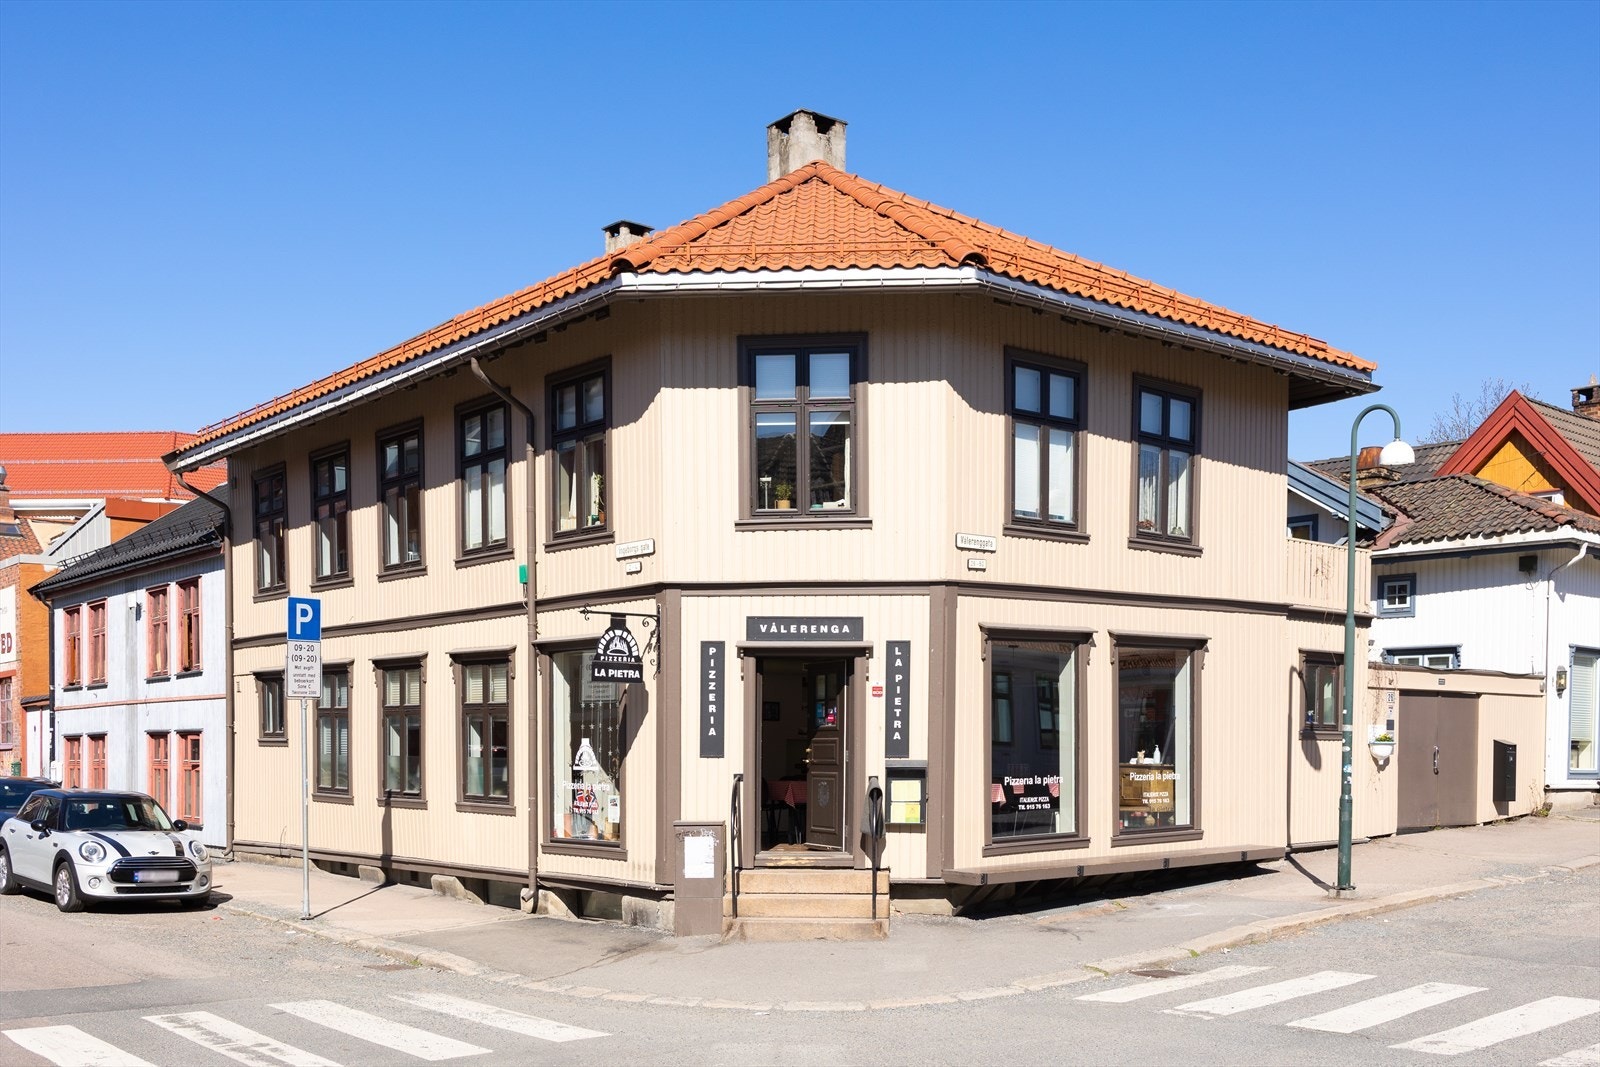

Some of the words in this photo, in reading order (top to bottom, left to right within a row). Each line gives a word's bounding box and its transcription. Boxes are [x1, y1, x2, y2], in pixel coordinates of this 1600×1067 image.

[295, 602, 313, 635] P
[759, 622, 850, 634] VÅLERENGA
[600, 655, 636, 663] PIZZERIA
[894, 646, 903, 667] LA
[594, 668, 606, 677] LA
[608, 668, 641, 679] PIETRA
[708, 646, 717, 736] PIZZERIA
[893, 674, 903, 740] PIETRA
[1004, 776, 1033, 786] Pizzeria
[1034, 775, 1042, 785] la
[1042, 774, 1064, 787] pietra
[1130, 771, 1155, 781] Pizzeria
[1155, 771, 1162, 780] la
[1162, 771, 1181, 782] pietra
